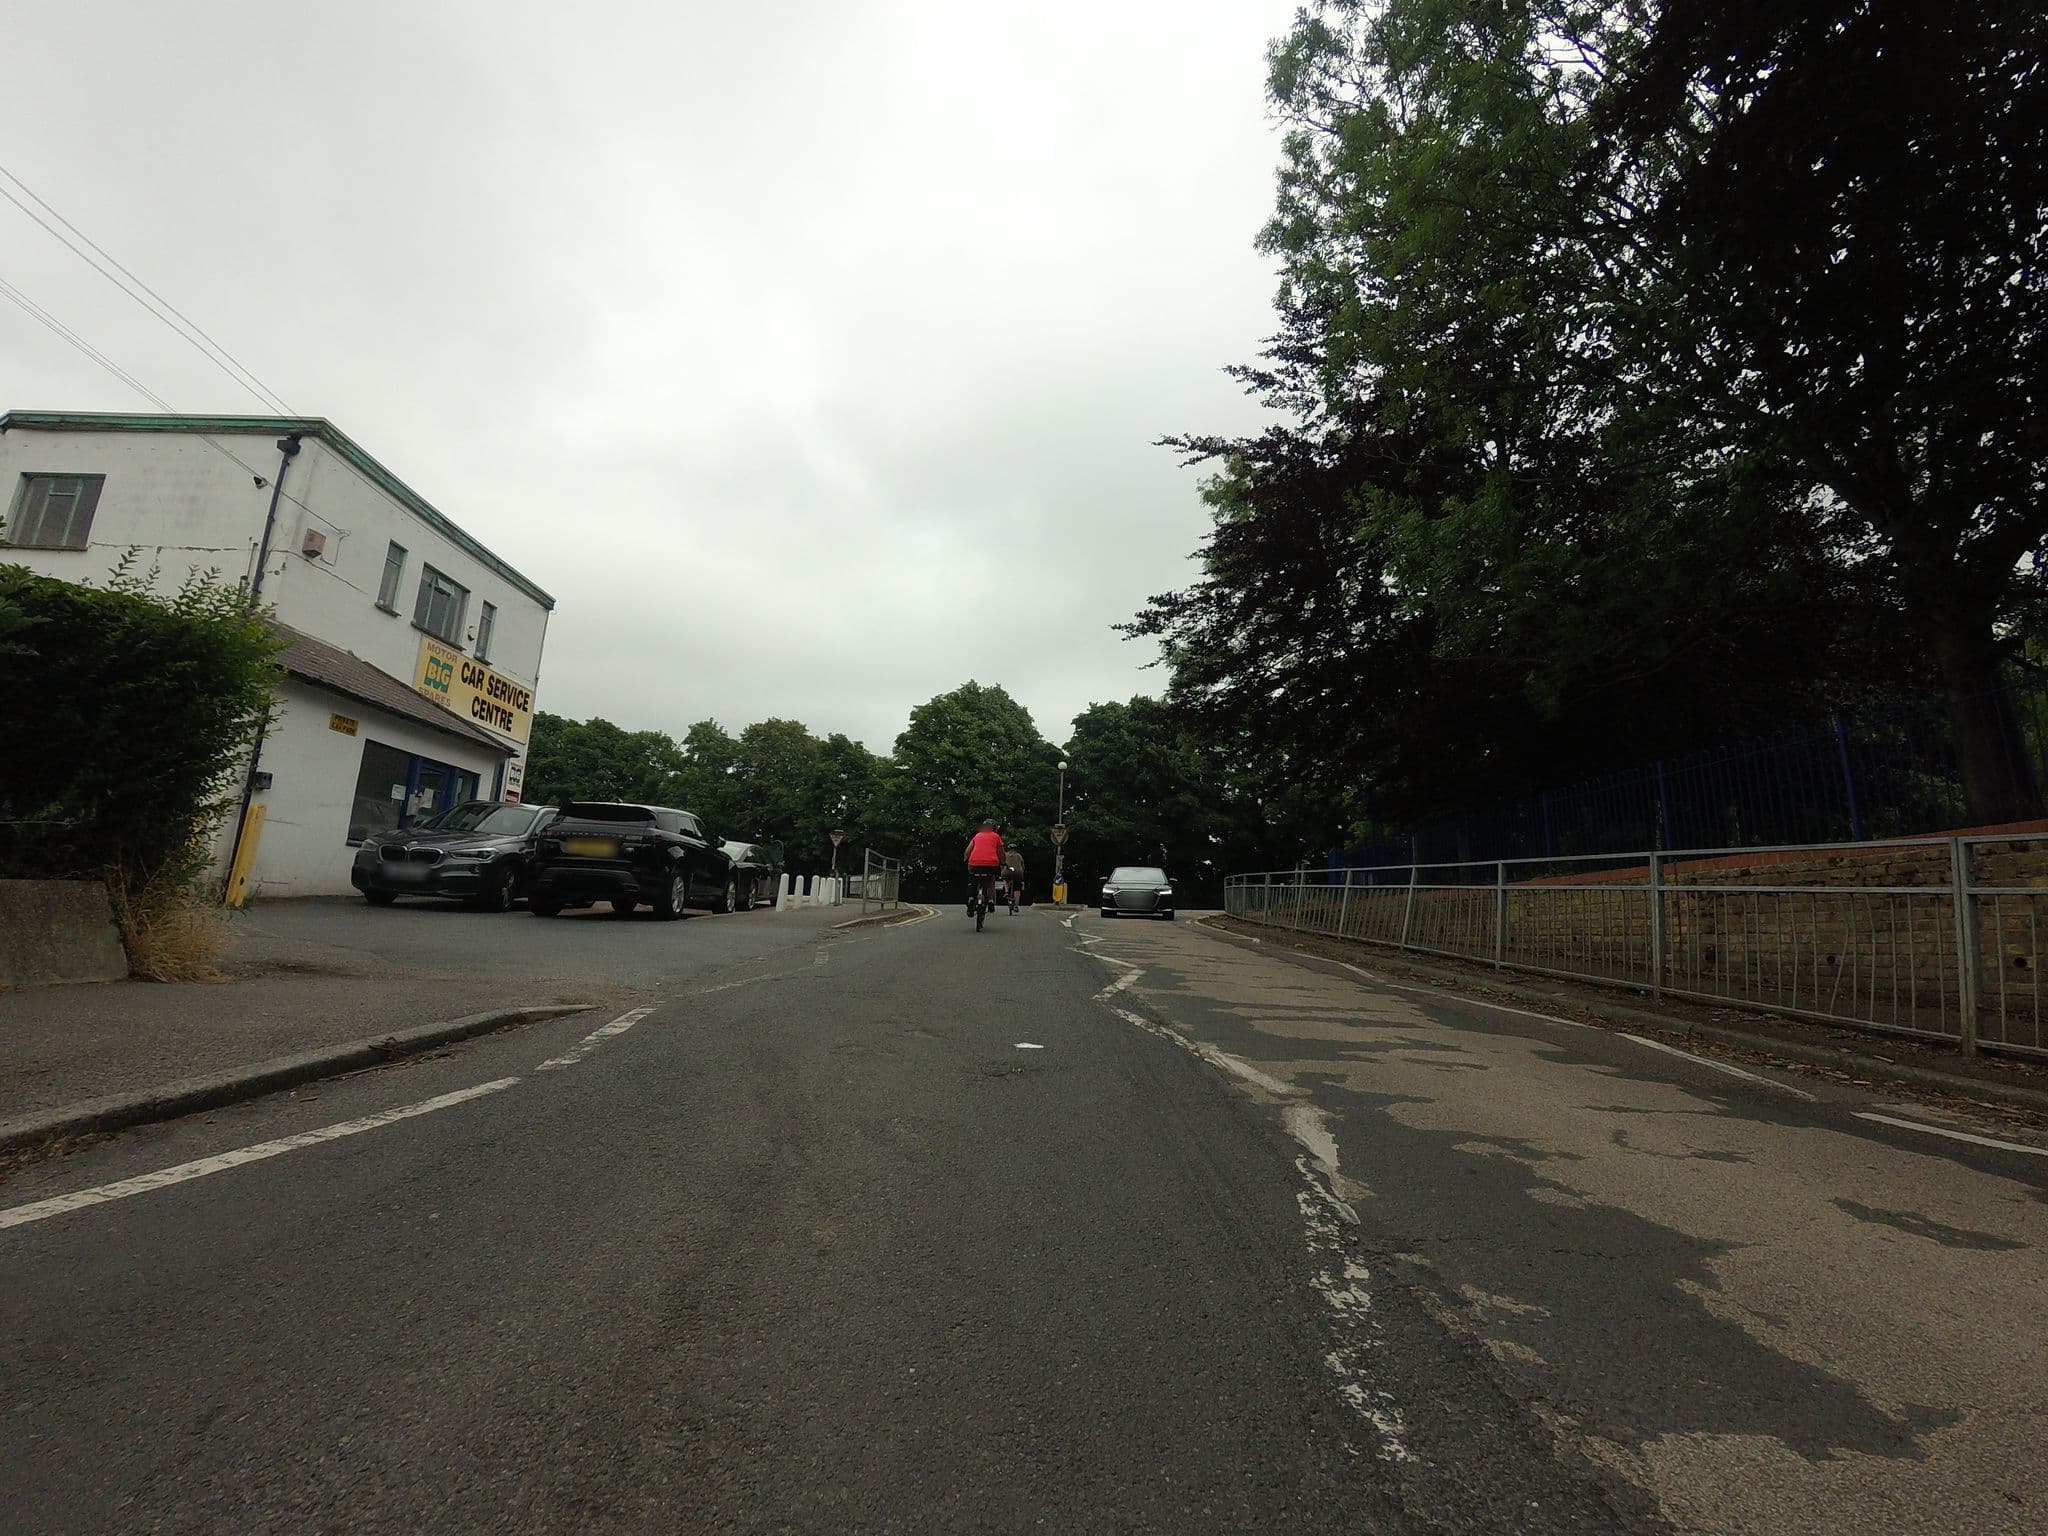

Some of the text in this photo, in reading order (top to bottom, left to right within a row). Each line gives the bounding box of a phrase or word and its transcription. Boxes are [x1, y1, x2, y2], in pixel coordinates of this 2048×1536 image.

[427, 642, 458, 663] MOTOR
[427, 661, 451, 686] BIG
[461, 662, 531, 713] CAR SERVICE
[471, 695, 514, 732] CENTRE
